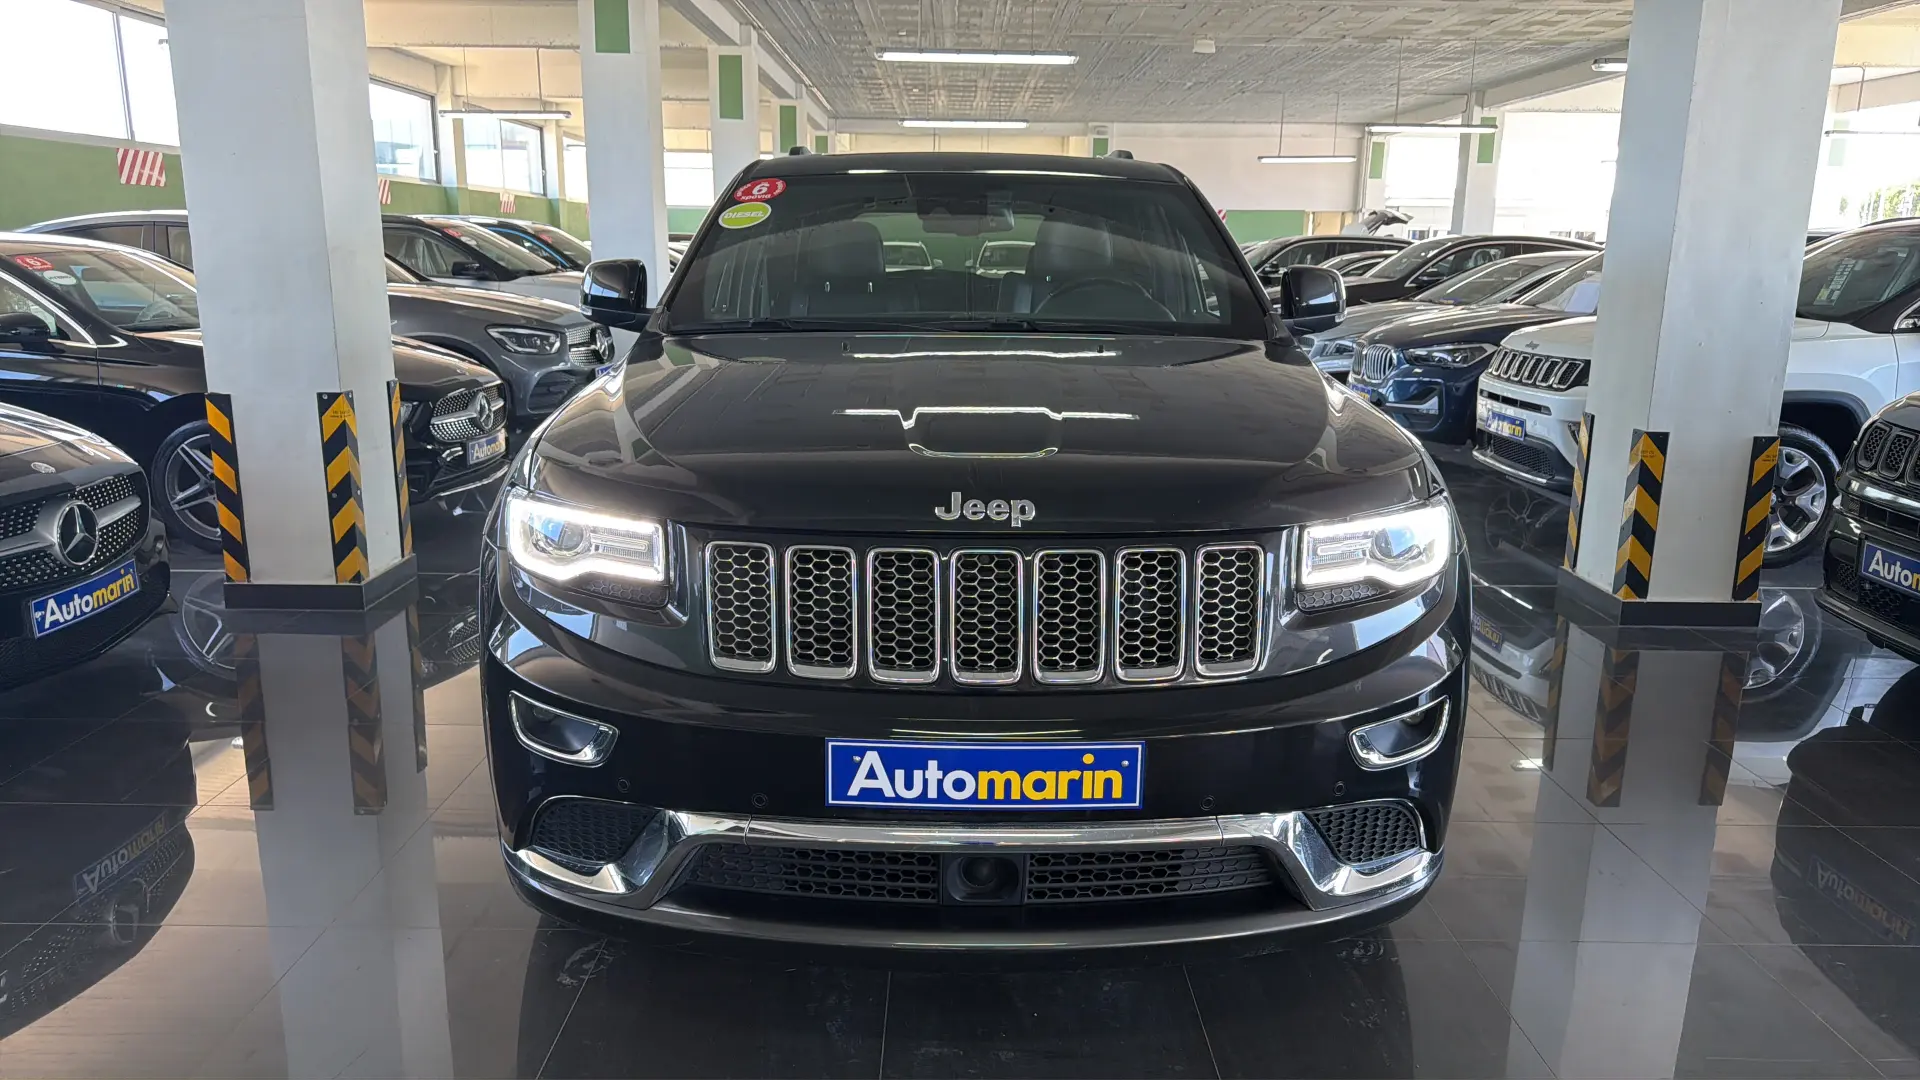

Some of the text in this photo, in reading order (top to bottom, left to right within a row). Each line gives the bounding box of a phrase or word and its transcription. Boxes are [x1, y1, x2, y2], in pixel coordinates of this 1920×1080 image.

[752, 183, 770, 195] 6
[935, 491, 1036, 527] Jeep
[45, 568, 134, 629] Automarin
[847, 750, 1123, 800] Automarin
